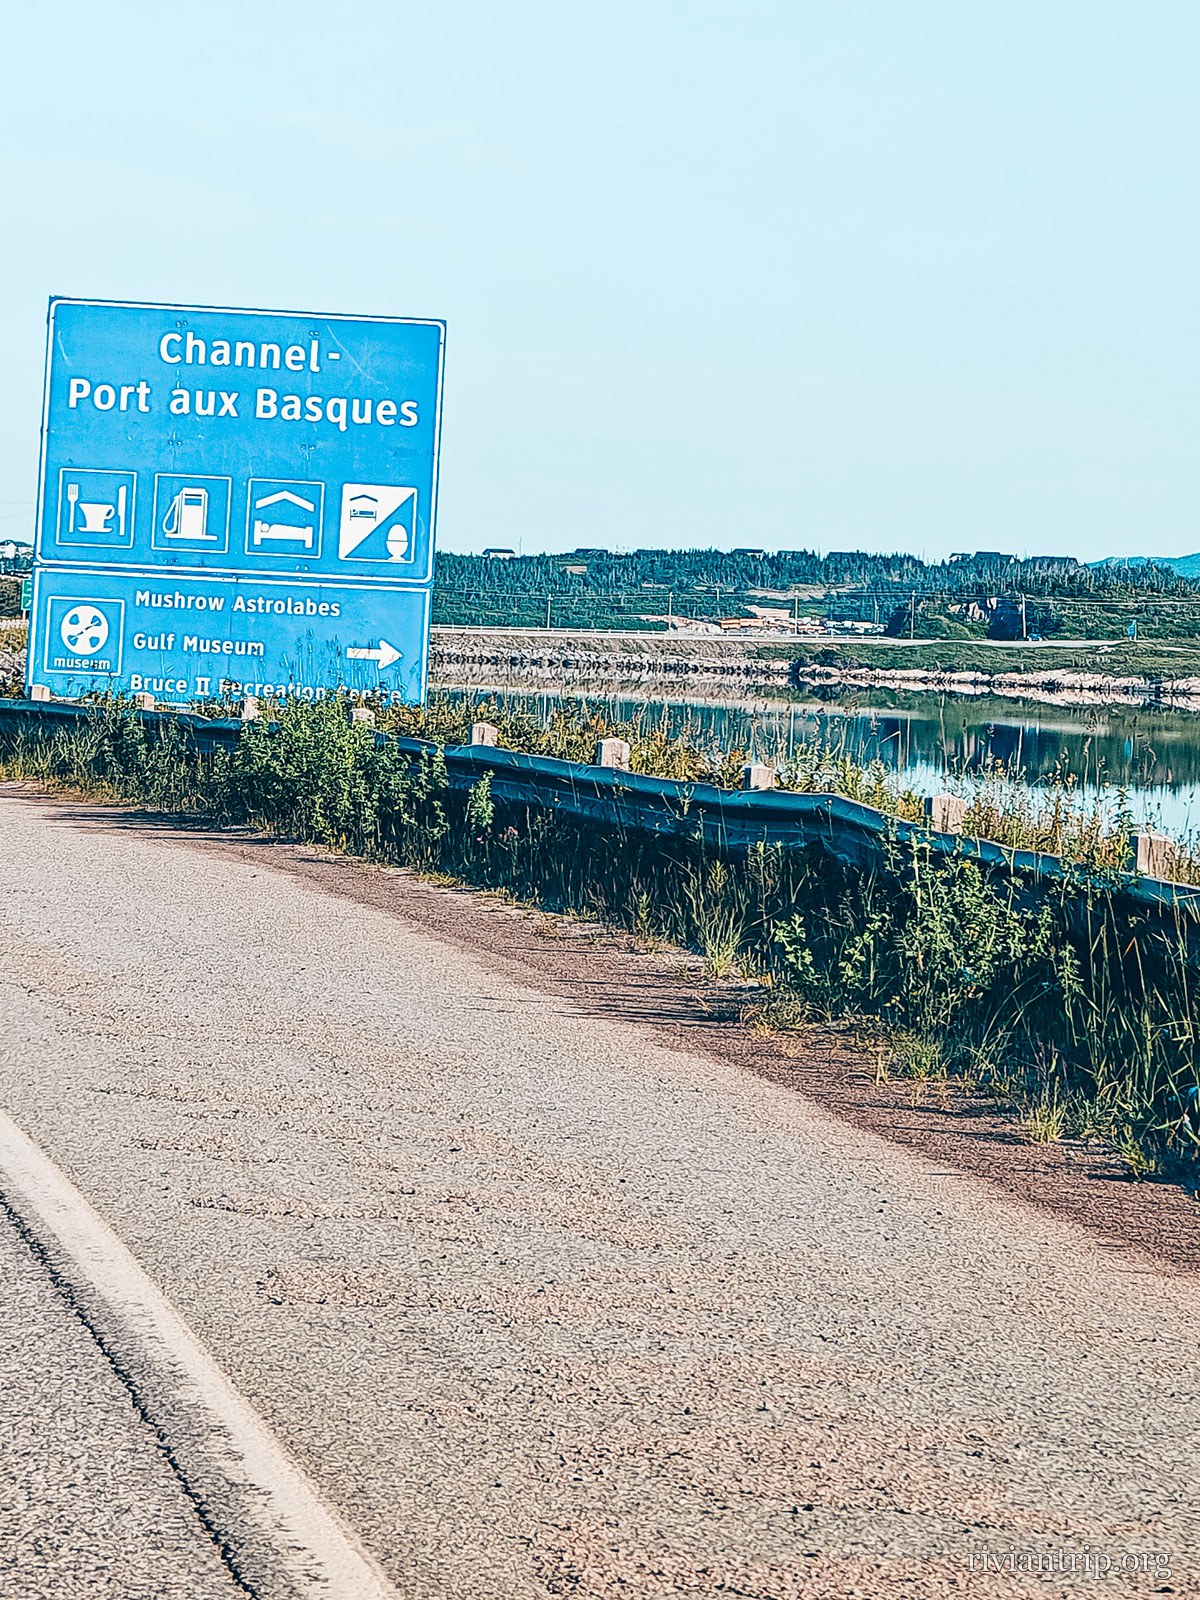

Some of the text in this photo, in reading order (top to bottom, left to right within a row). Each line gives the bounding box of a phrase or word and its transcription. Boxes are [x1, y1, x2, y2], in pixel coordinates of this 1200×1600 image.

[159, 332, 341, 373] Channel-
[68, 378, 420, 431] Port aux Basques
[135, 590, 341, 617] Mushrow Astrolabes
[133, 633, 265, 657] Gulf Museum
[53, 657, 111, 670] museum
[130, 673, 188, 694] Bruce
